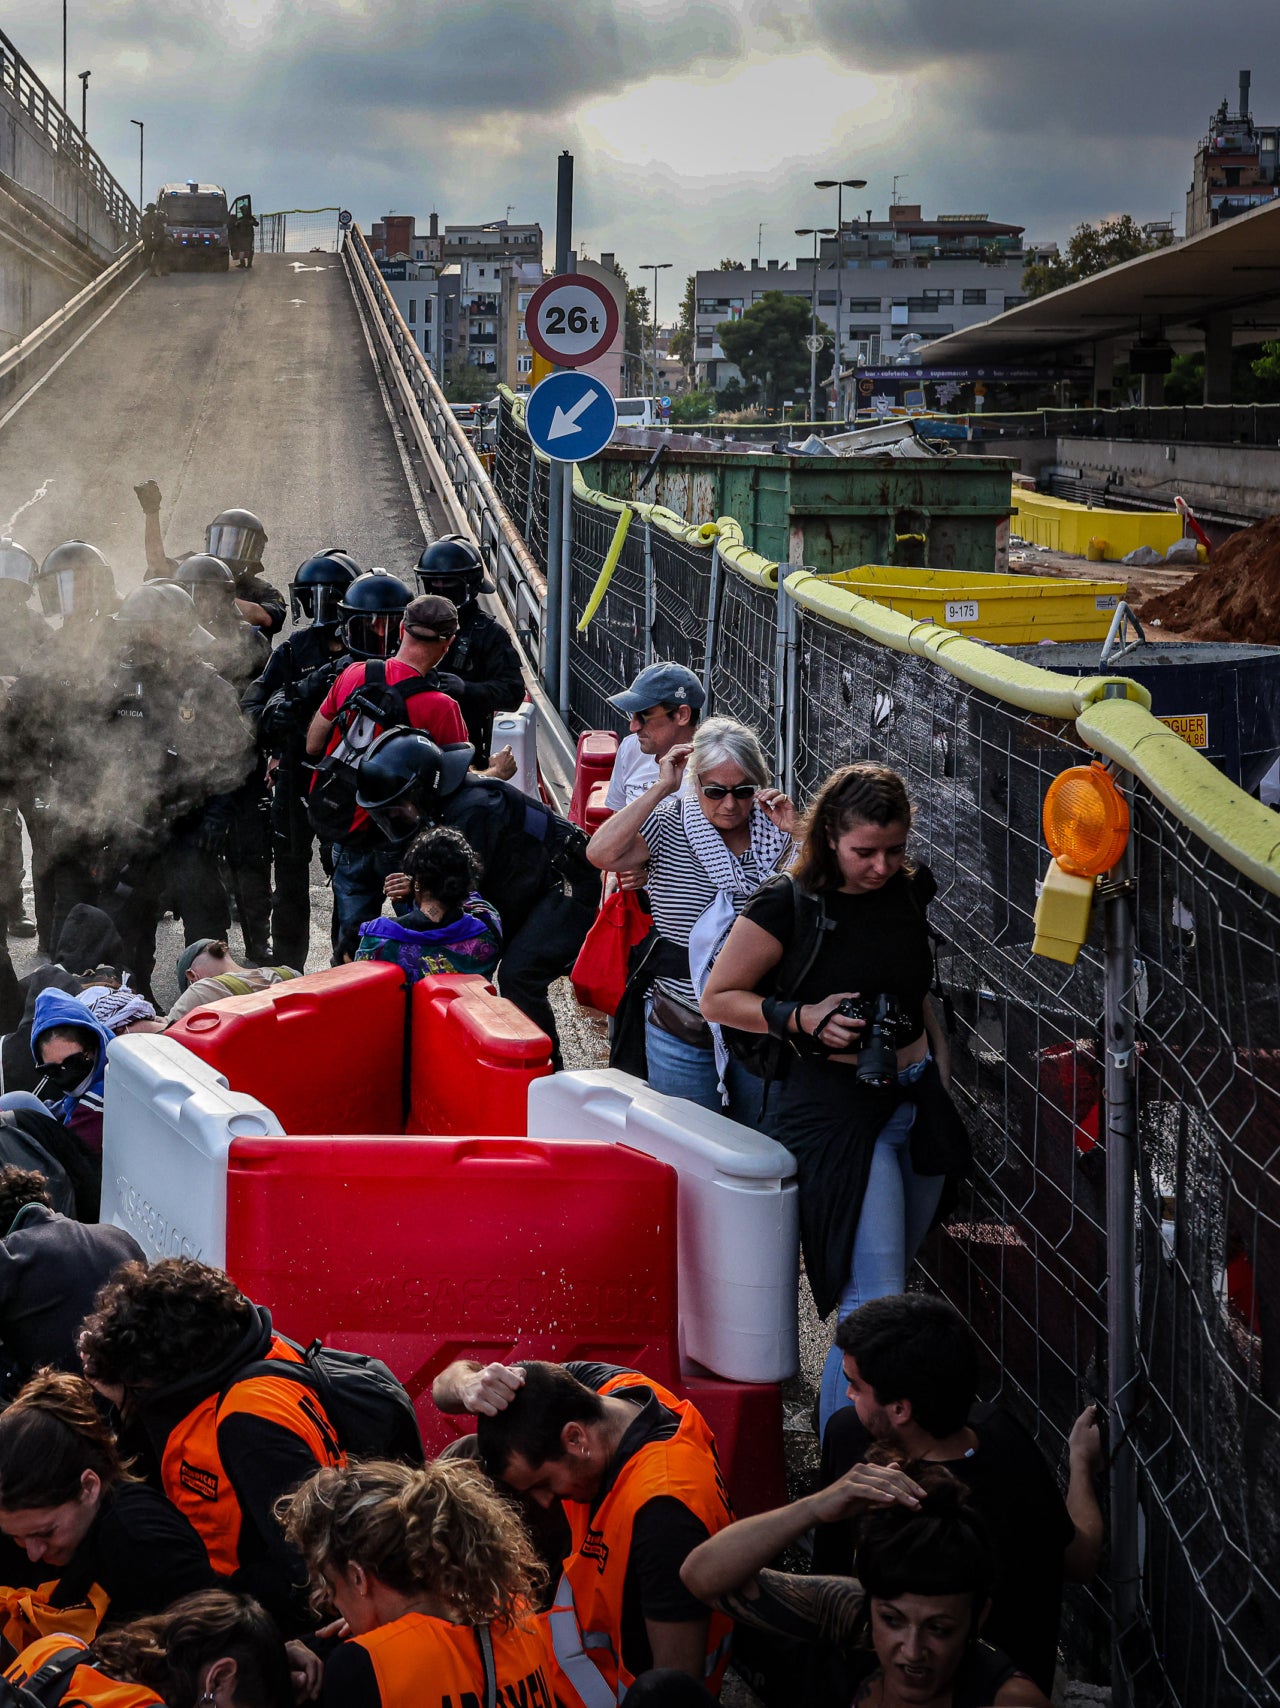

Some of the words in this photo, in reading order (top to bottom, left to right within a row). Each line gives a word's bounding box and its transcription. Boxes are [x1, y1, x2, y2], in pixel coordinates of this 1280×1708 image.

[949, 605, 975, 618] 9-175
[117, 709, 144, 719] POLICIA
[1194, 733, 1205, 745] 86
